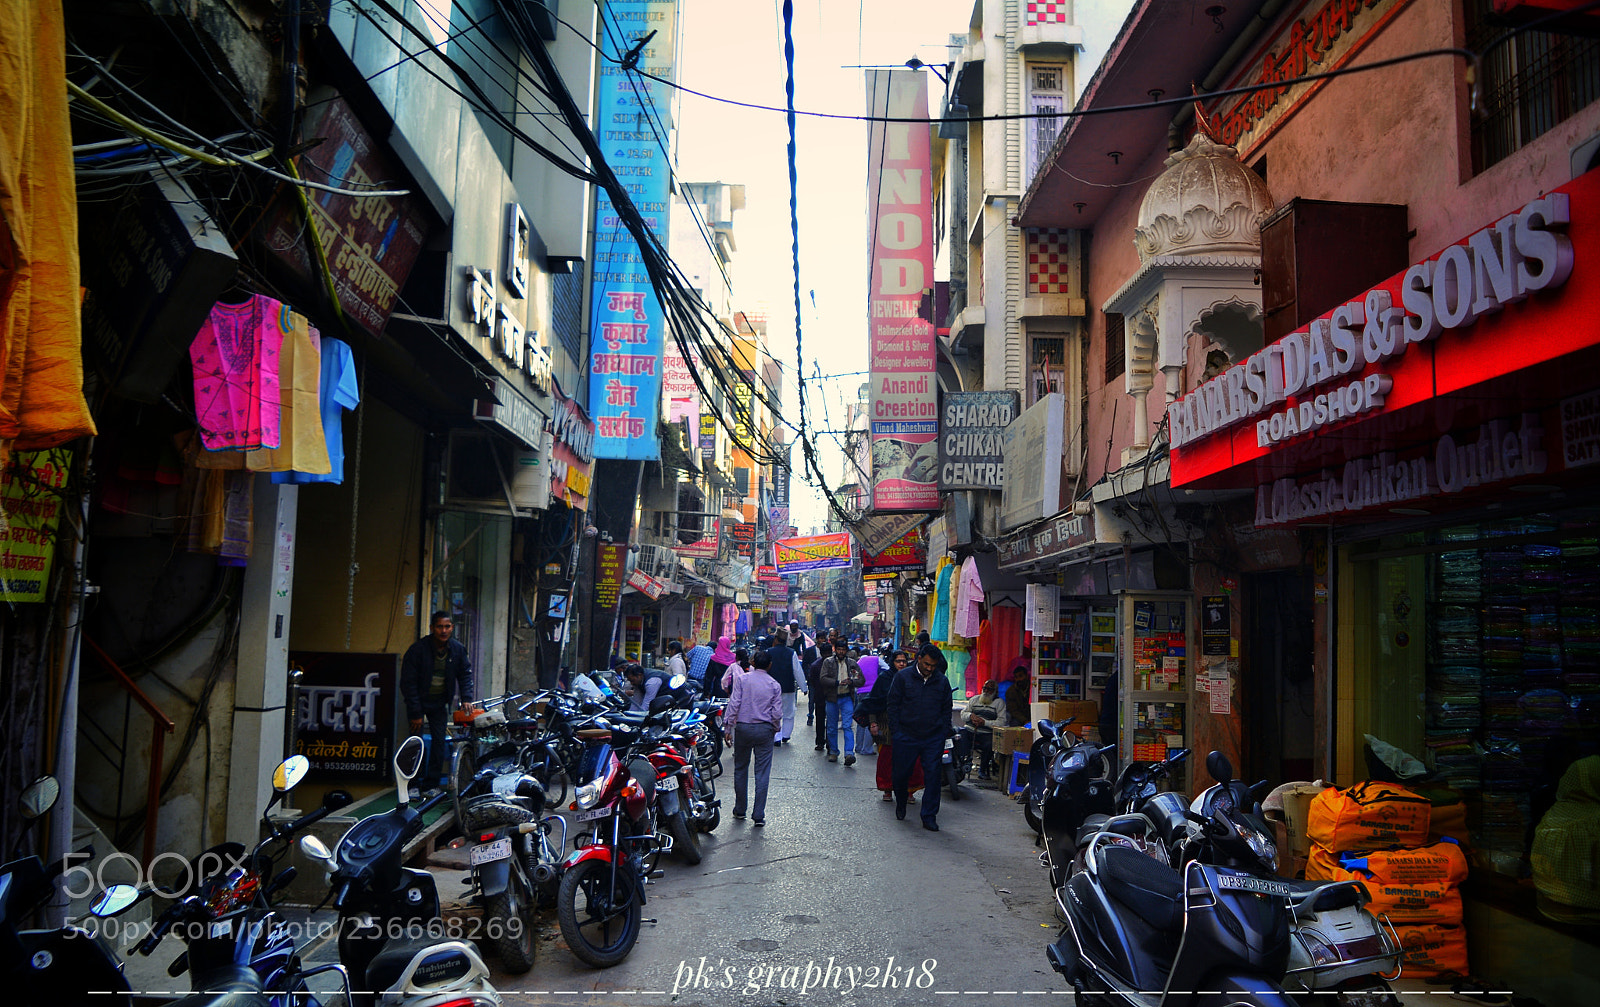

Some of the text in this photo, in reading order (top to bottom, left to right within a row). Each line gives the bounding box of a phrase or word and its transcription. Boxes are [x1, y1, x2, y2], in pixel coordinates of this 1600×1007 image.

[617, 81, 653, 91] SILVER
[627, 149, 653, 158] 92.50
[611, 166, 653, 177] SILVER
[877, 81, 924, 295] VINOD
[607, 292, 647, 321] जम्बू
[872, 301, 921, 318] JEWELLE
[1169, 192, 1574, 449] BANARSI DAS & SONS
[601, 323, 649, 350] कुमार
[878, 324, 929, 336] Hallmarked Gold
[877, 340, 930, 351] Diamond & Silver
[592, 353, 656, 375] अध्यात्म
[875, 355, 933, 370] Designer Jewellery
[606, 378, 638, 406] जैन
[881, 375, 929, 394] Anandi
[875, 399, 936, 417] Creation
[945, 405, 1012, 428] SHARAD
[1256, 373, 1393, 448] ROADSHOP
[598, 411, 645, 438] सर्राफ
[875, 421, 937, 433] Vinod Maheshwari
[945, 434, 1005, 457] CHIKAN
[1342, 450, 1433, 511] Chikan
[1435, 411, 1549, 494] Outlet
[943, 463, 1004, 485] CENTRE
[863, 514, 914, 549] COMPAN
[803, 544, 848, 559] TOUNCH
[351, 741, 379, 759] शॉप
[1360, 820, 1394, 830] BANARSI
[1385, 887, 1440, 898] BANARSI DAS
[416, 960, 460, 975] Mahindra
